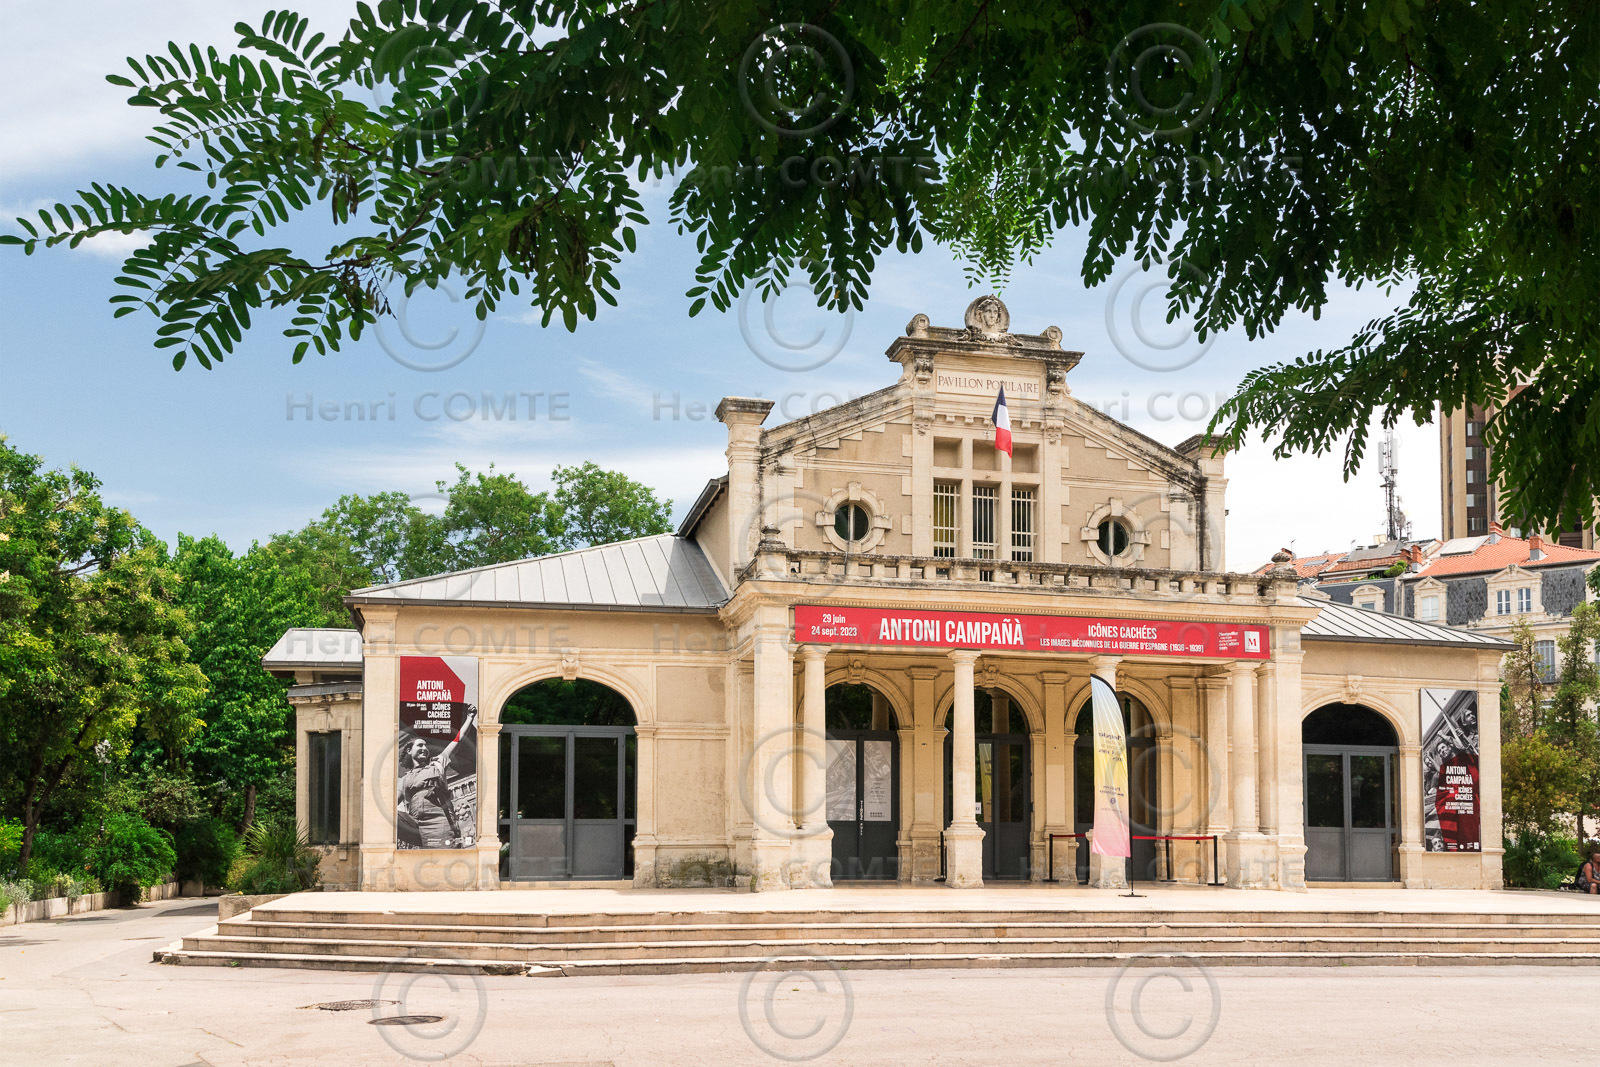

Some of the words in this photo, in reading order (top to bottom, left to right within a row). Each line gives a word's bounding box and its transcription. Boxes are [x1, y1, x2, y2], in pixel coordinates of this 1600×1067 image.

[938, 376, 983, 389] PAVILLON
[986, 379, 1039, 394] POULAIRE
[822, 613, 832, 623] 29
[832, 614, 846, 625] juin
[811, 625, 821, 636] 24
[821, 626, 839, 638] sept.
[840, 626, 857, 637] 2023
[879, 617, 941, 642] ANTONI
[945, 618, 1024, 646] CAMPAÑÀ
[1088, 622, 1119, 638] ICÔNES
[1120, 624, 1157, 640] CACHÉES
[1040, 638, 1050, 647] LES
[1050, 638, 1071, 648] IMAGES
[1071, 638, 1103, 649] MÉCONNUES
[1103, 640, 1111, 649] DE
[1111, 640, 1118, 649] LA
[1119, 641, 1140, 650] GUERRE
[1140, 642, 1168, 651] D'ESPAGNE
[417, 680, 443, 690] ANTONI
[417, 690, 452, 701] CAMPAÑÀ
[432, 702, 451, 711] ICÔNES
[427, 710, 451, 719] CACHÉES
[1446, 765, 1467, 775] ANTONI
[1446, 774, 1473, 785] CAMPAÑÀ
